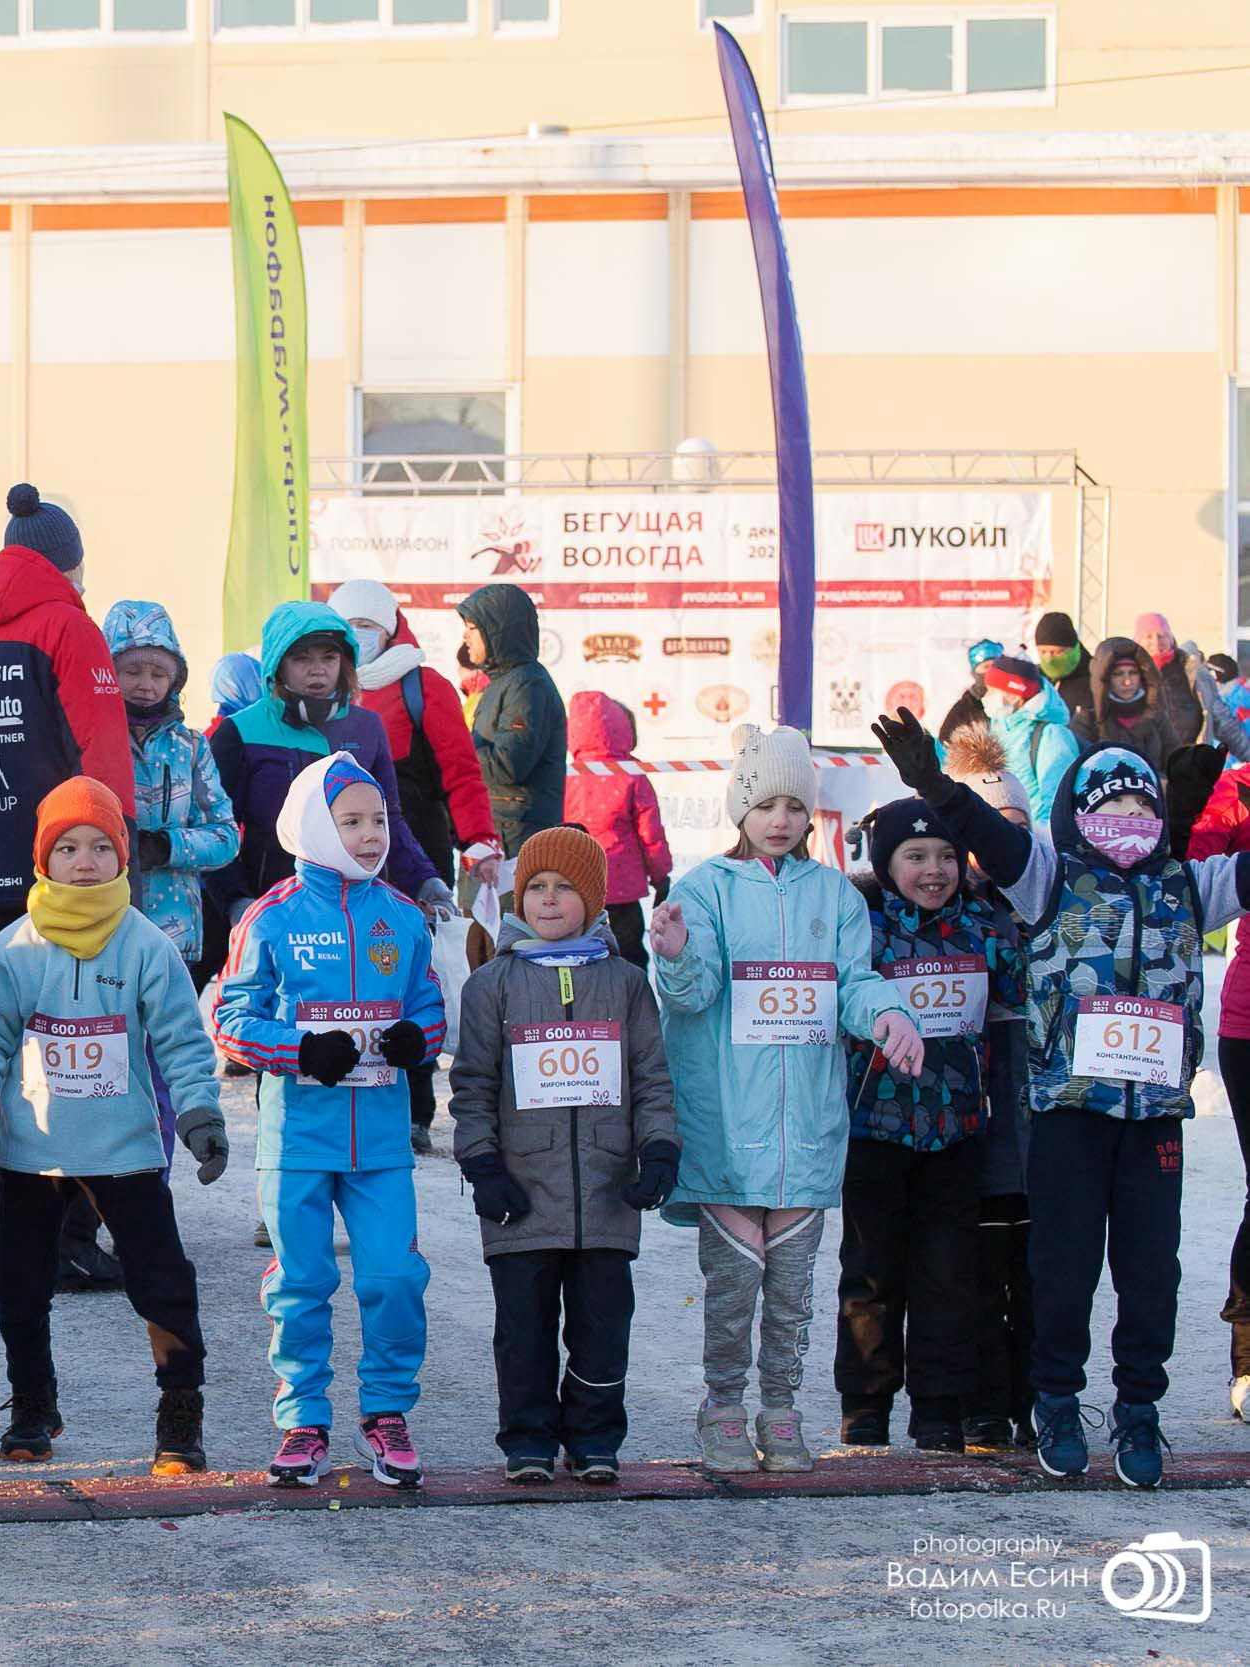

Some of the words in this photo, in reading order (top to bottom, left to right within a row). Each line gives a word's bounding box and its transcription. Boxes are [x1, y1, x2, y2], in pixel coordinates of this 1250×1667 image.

[563, 511, 703, 536] БЕГУЩАЯ
[888, 521, 1008, 549] ЛУКОЙЛ
[563, 546, 703, 572] ВОЛОГДА
[749, 546, 775, 559] 202
[1076, 777, 1158, 816] LBRUS
[1079, 826, 1120, 838] РУС
[288, 931, 347, 945] LUKOIL
[768, 967, 794, 978] 600
[916, 962, 941, 974] 600
[759, 986, 816, 1015] 633
[910, 980, 967, 1009] 625
[334, 1008, 360, 1019] 600
[1114, 1001, 1142, 1014] 600
[51, 1024, 75, 1035] 600
[350, 1027, 383, 1056] 08
[545, 1027, 572, 1039] 600
[1103, 1020, 1161, 1054] 612
[45, 1042, 103, 1070] 619
[538, 1047, 599, 1077] 606
